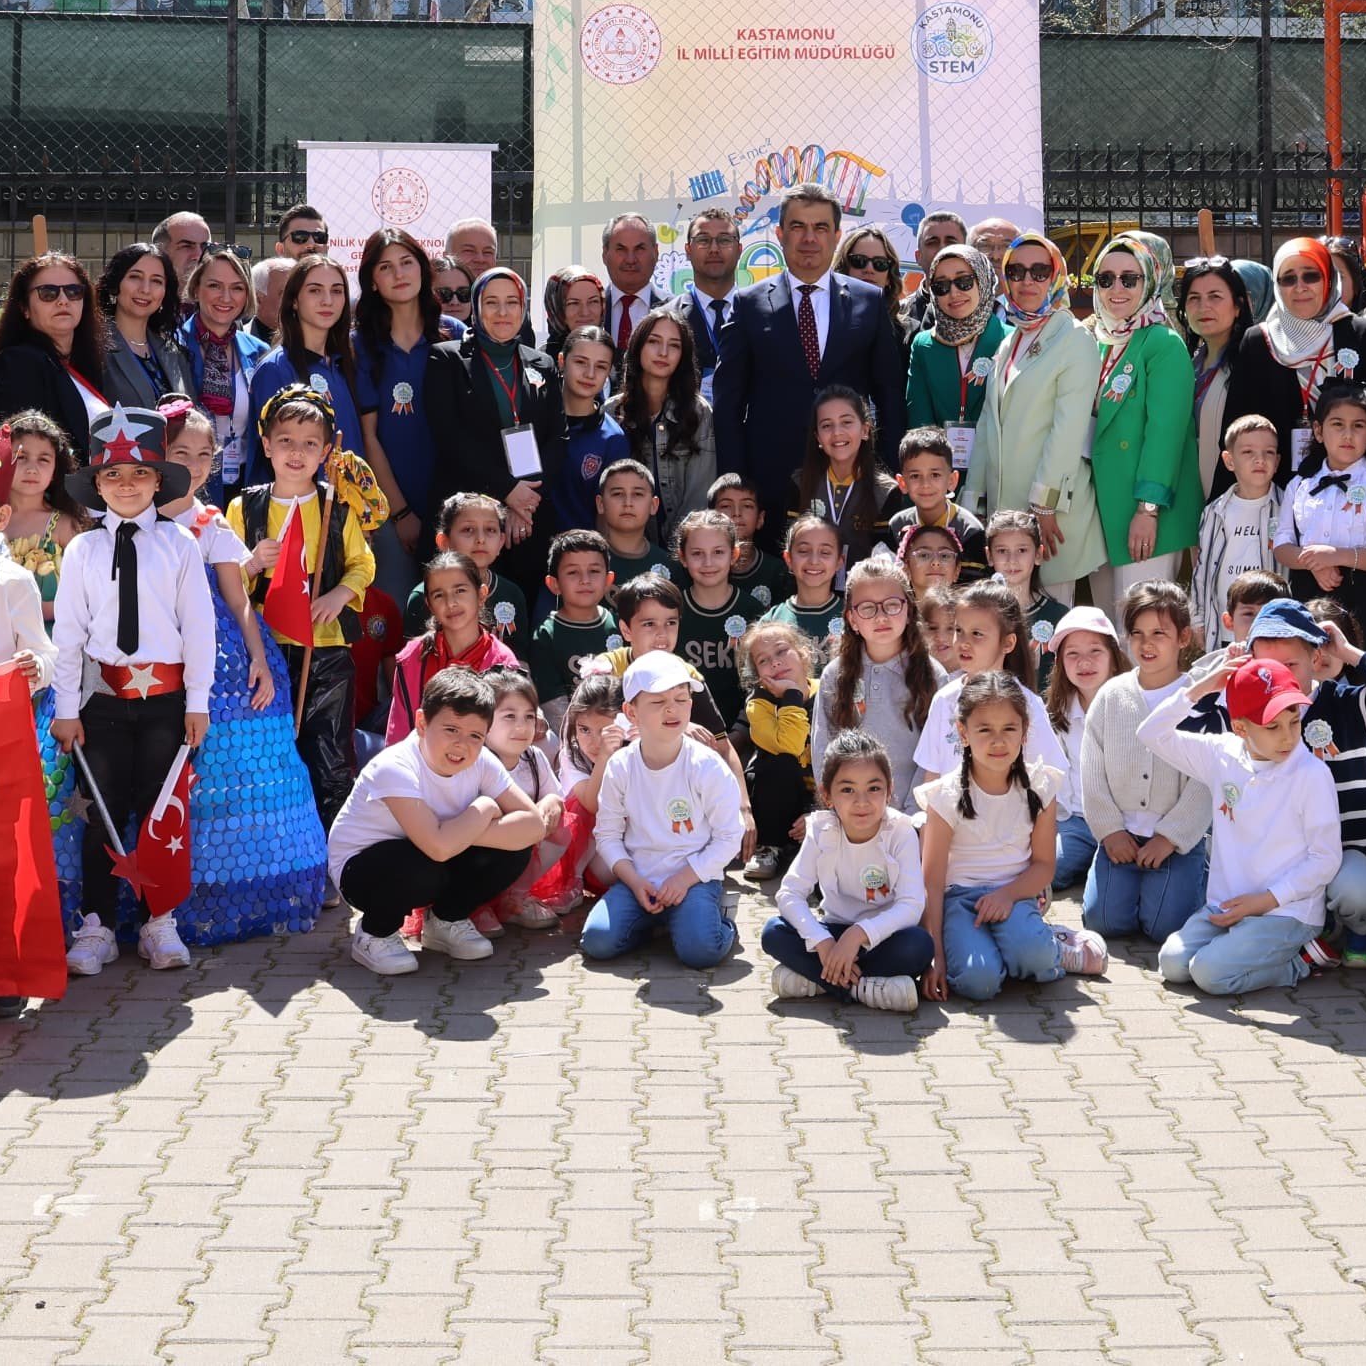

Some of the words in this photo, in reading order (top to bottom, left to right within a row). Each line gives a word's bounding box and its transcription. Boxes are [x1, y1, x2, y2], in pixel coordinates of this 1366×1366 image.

[919, 6, 984, 30] KASTAMONU
[737, 28, 835, 40] KASTAMONU
[677, 45, 690, 60] İL
[738, 45, 790, 59] EĞİTİM
[794, 44, 895, 59] MÜDÜRLÜĞÜ
[929, 61, 975, 74] STEM
